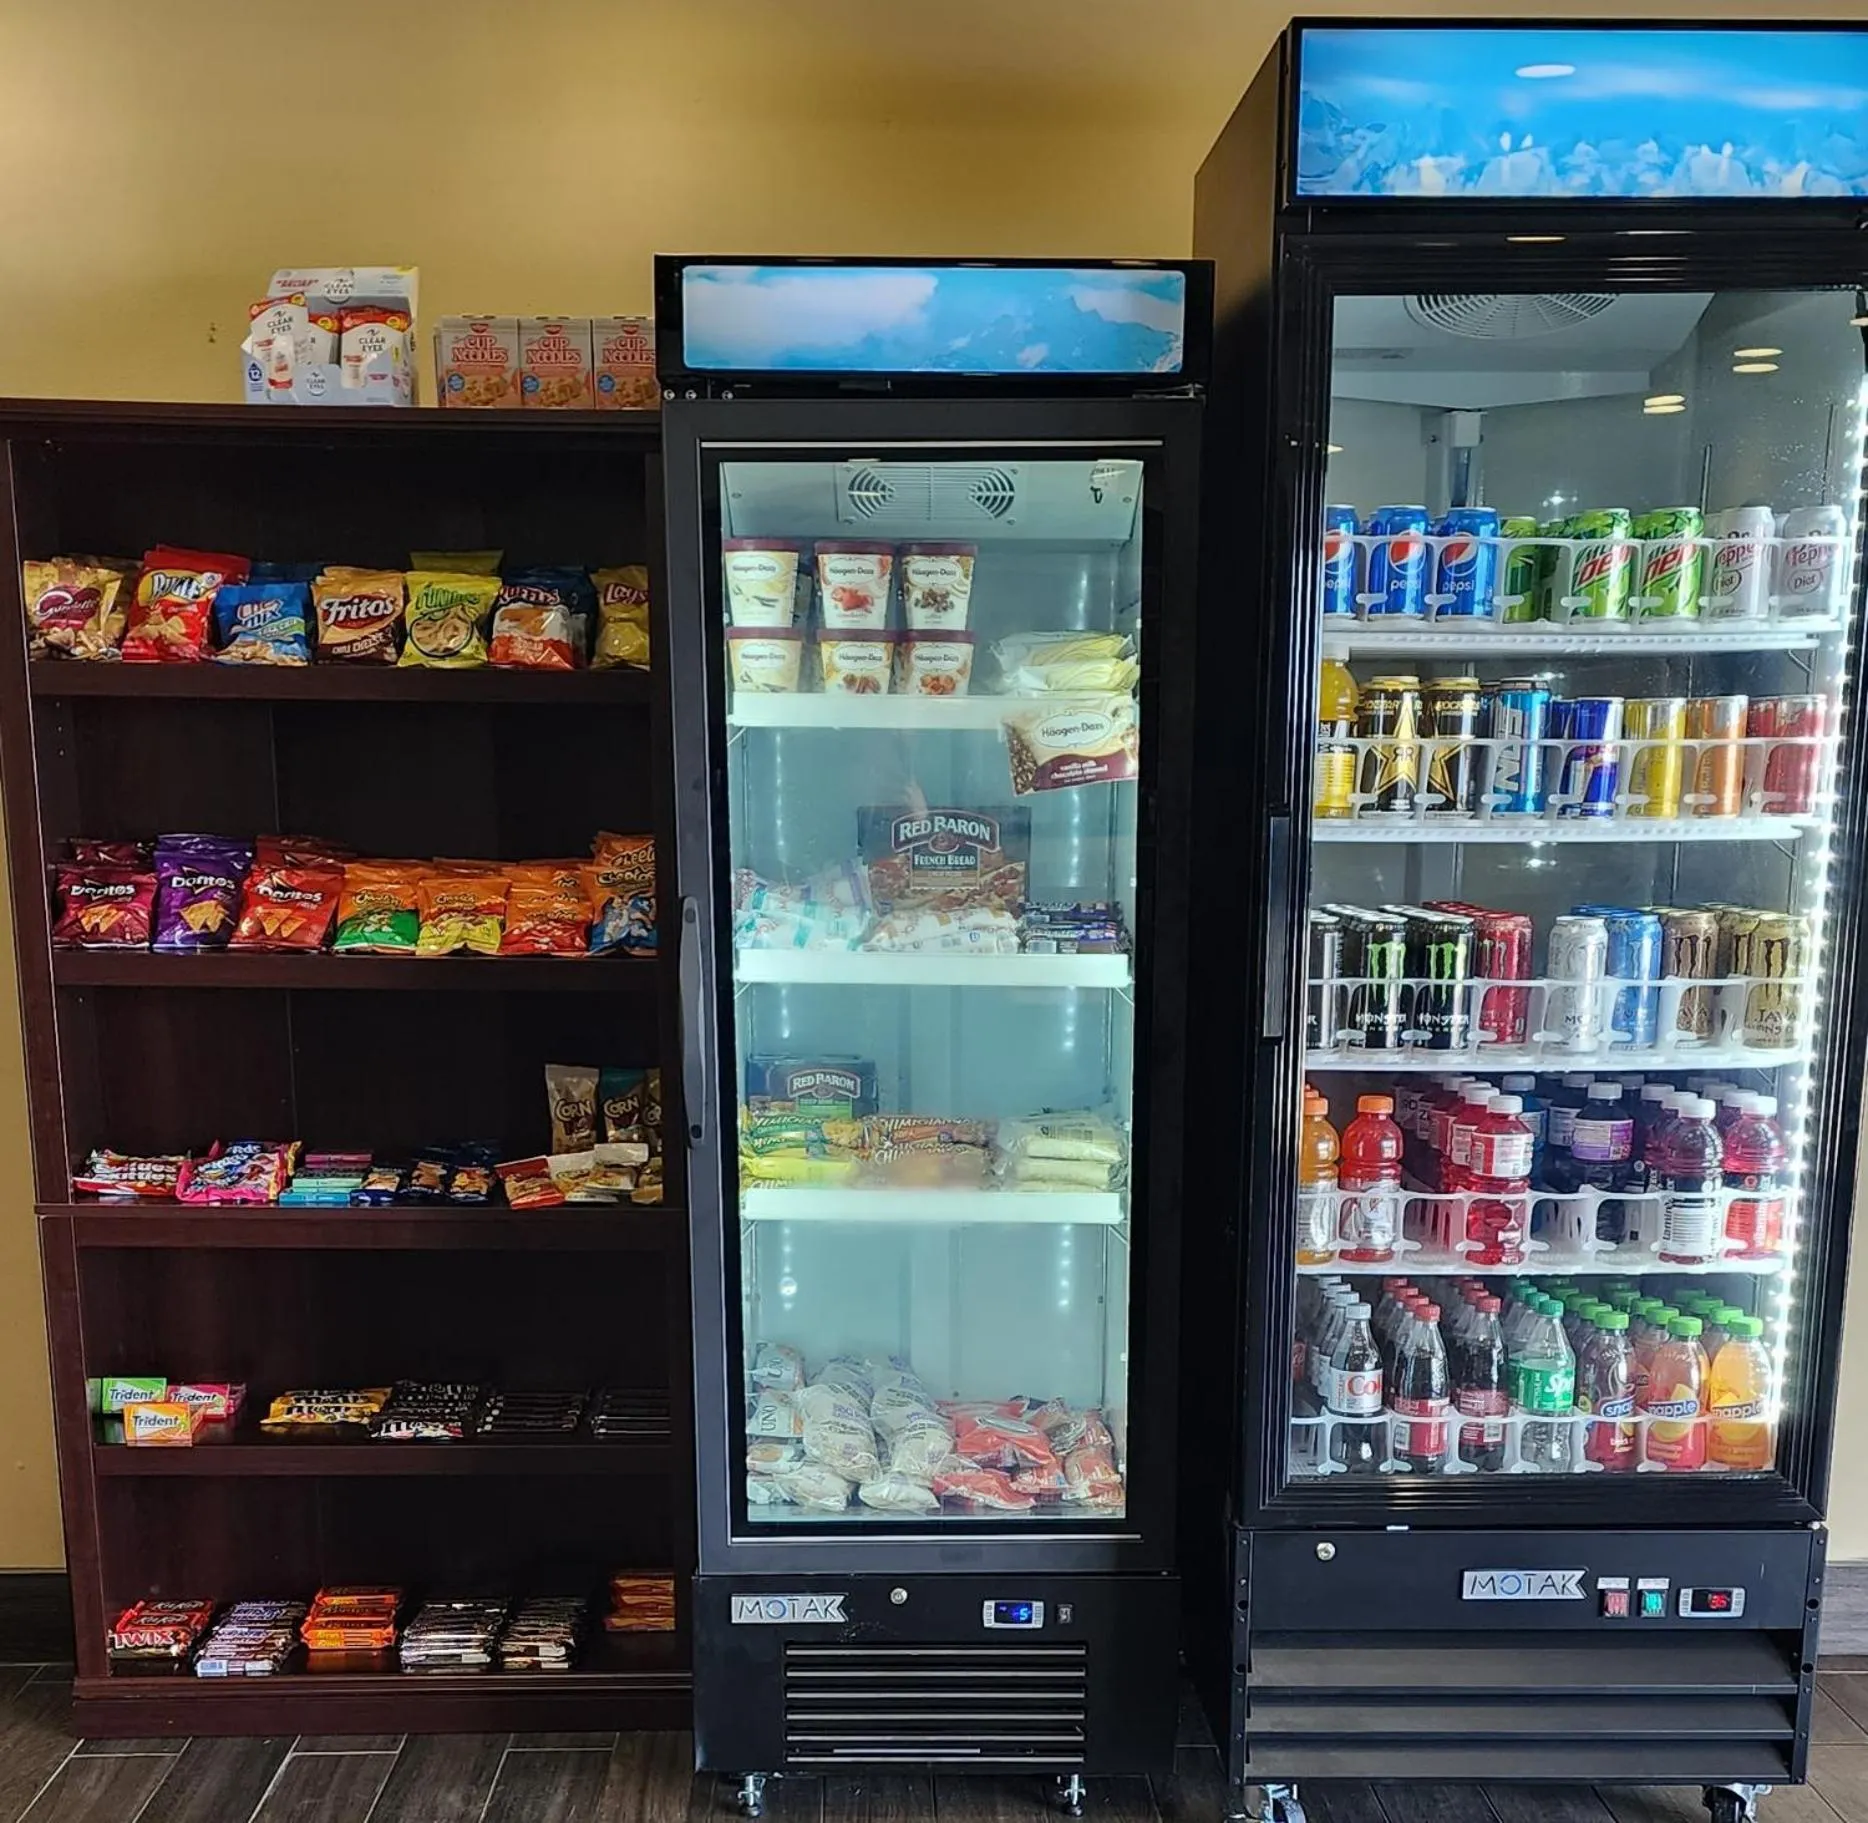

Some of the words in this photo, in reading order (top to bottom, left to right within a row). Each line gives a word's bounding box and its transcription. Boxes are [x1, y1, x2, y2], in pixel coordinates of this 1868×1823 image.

[271, 324, 292, 334] EYES
[361, 344, 383, 352] EYES
[465, 336, 497, 349] CUP
[539, 337, 570, 350] CUP
[616, 337, 648, 350] CUP
[452, 347, 509, 364] NOODLES
[525, 348, 582, 365] NOODLES
[1442, 579, 1474, 593] pepsi
[1794, 574, 1816, 589] Diet
[320, 594, 396, 626] Fritos
[900, 820, 932, 841] RED
[933, 816, 990, 841] BARON
[914, 854, 945, 866] FRENCH
[947, 854, 976, 866] BREAD
[171, 875, 236, 890] Doritos
[70, 884, 136, 897] Doritos
[256, 884, 323, 902] Doritos
[792, 1077, 814, 1090] RED
[816, 1073, 855, 1091] BARON
[555, 1099, 594, 1122] CORN
[604, 1095, 640, 1119] CORN
[109, 1388, 155, 1401] Trident
[171, 1391, 217, 1402] Trident
[132, 1415, 179, 1428] Trident
[761, 1405, 778, 1432] UNO
[1470, 1573, 1576, 1596] MOTAK
[738, 1597, 838, 1622] MOTAK
[109, 1630, 175, 1649] TWIX
